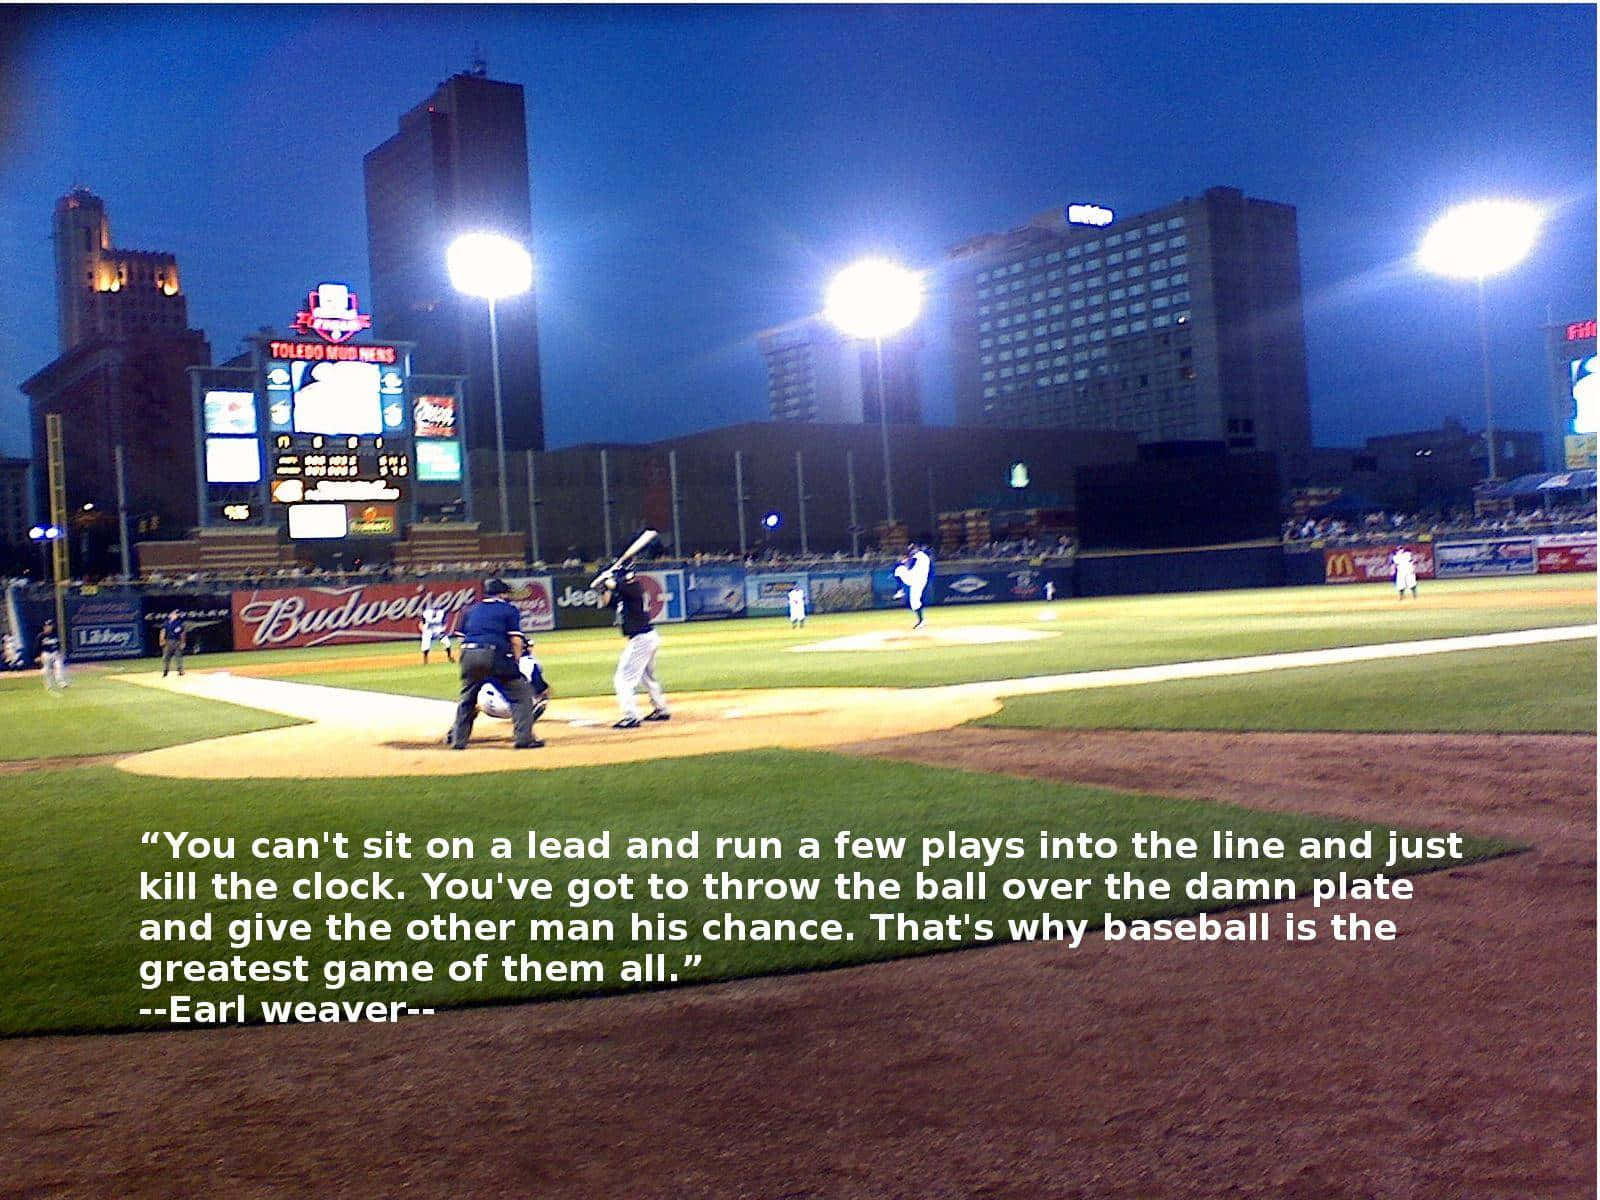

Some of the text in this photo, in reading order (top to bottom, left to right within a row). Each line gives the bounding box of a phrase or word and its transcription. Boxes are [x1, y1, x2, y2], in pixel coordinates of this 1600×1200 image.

[270, 341, 324, 360] TOLEDO
[144, 609, 229, 620] CHYSLER
[240, 583, 476, 643] Budweiser
